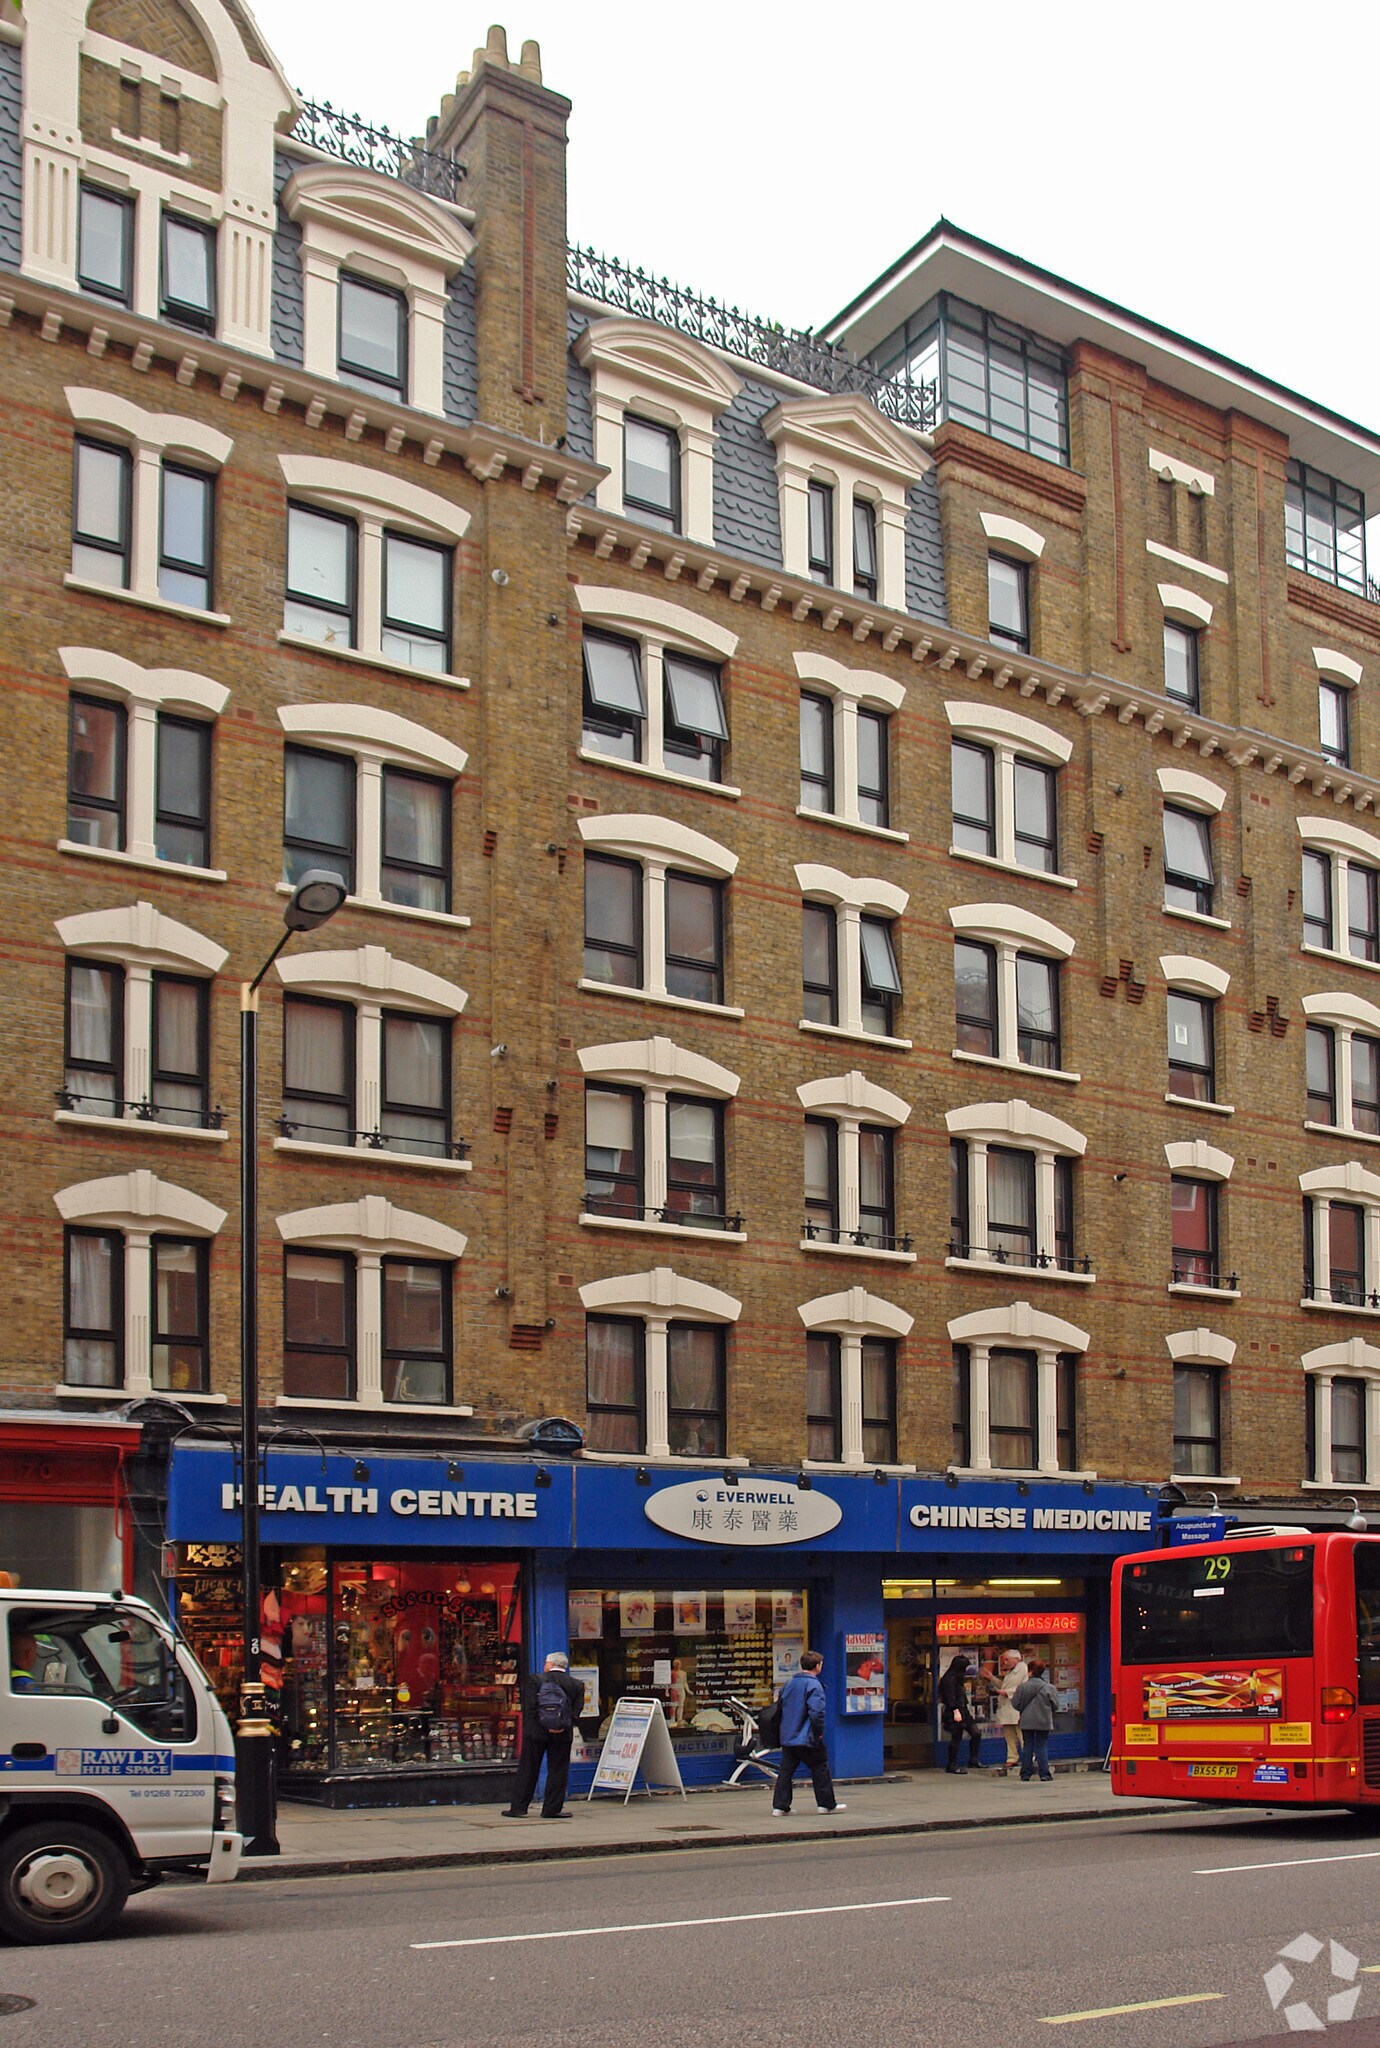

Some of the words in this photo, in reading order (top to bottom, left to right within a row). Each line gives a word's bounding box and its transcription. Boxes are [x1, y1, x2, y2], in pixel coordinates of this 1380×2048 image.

[221, 1483, 378, 1514] HEALTH
[390, 1489, 538, 1518] CENTRE
[716, 1490, 795, 1505] EVERWELL
[691, 1507, 799, 1532] 康泰醫藥
[909, 1504, 1026, 1529] CHINESE
[1032, 1508, 1152, 1531] MEDICINE
[1175, 1521, 1217, 1530] Acupuncture
[1181, 1533, 1210, 1541] Massage
[1204, 1555, 1231, 1581] 29
[938, 1618, 983, 1631] HERBS
[985, 1617, 1013, 1630] ACU
[1017, 1616, 1077, 1630] MASSAGE
[251, 1638, 259, 1654] 20
[82, 1750, 170, 1765] RAWLEY
[82, 1765, 124, 1775] HIRE
[125, 1765, 170, 1775] SPACE
[1193, 1765, 1217, 1776] BX55
[1218, 1765, 1237, 1777] FXP
[129, 1789, 141, 1798] Tel
[144, 1789, 170, 1798] 01268
[173, 1789, 205, 1798] 722300
